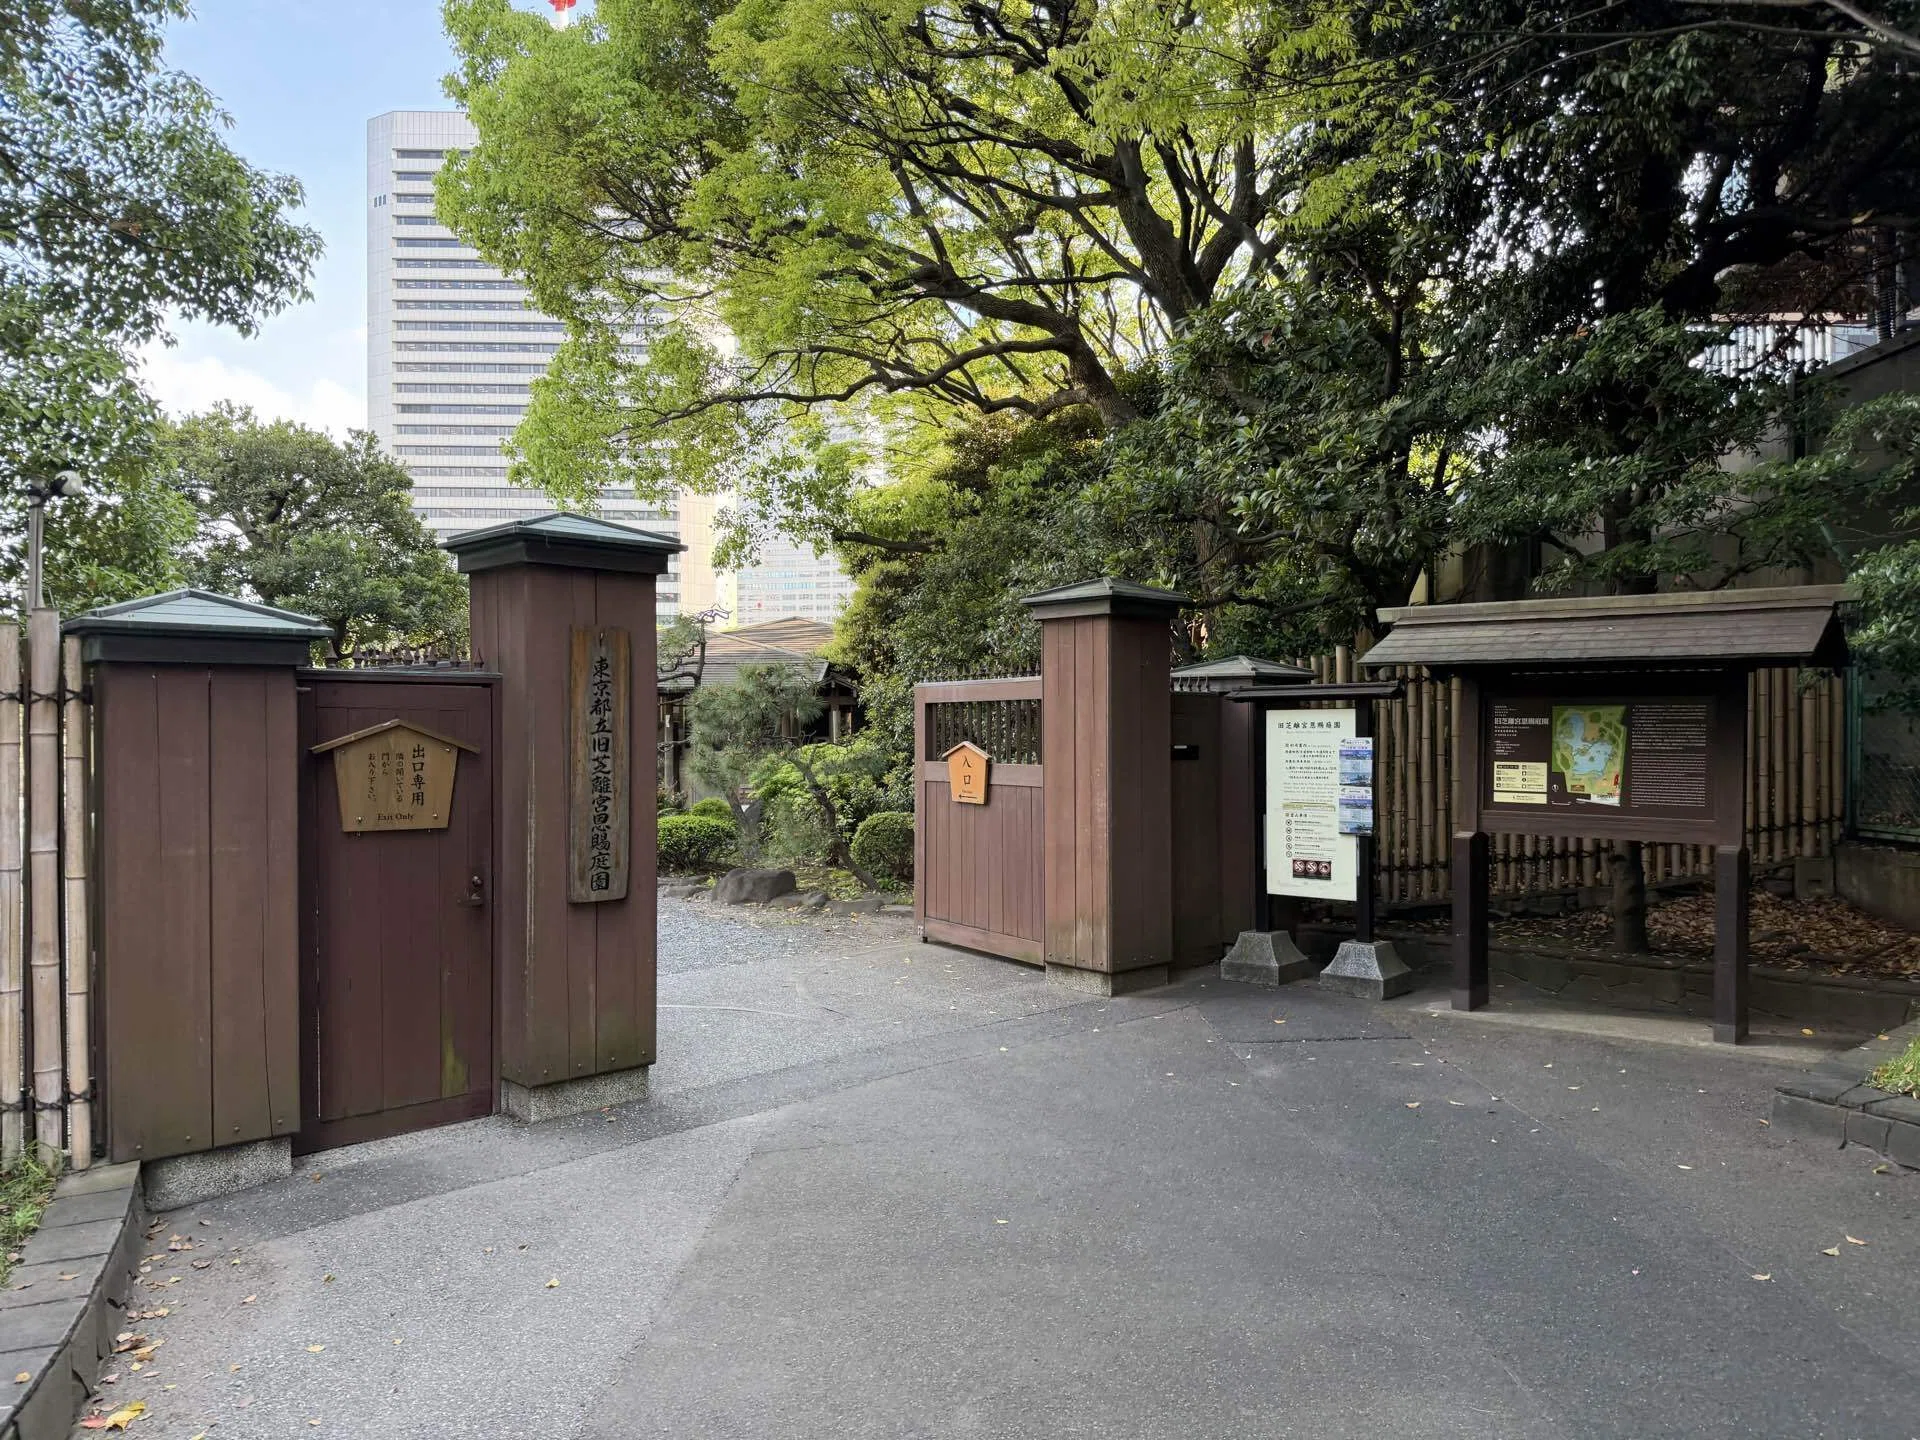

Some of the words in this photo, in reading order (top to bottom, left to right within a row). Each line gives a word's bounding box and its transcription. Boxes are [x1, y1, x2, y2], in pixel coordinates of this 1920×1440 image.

[381, 752, 391, 776] 門から
[411, 744, 426, 806] 出口専用
[589, 656, 613, 891] 東京都立旧芝離宮恩賜庭園
[962, 755, 972, 785] 入口
[377, 813, 393, 821] Exit
[395, 812, 414, 821] Only
